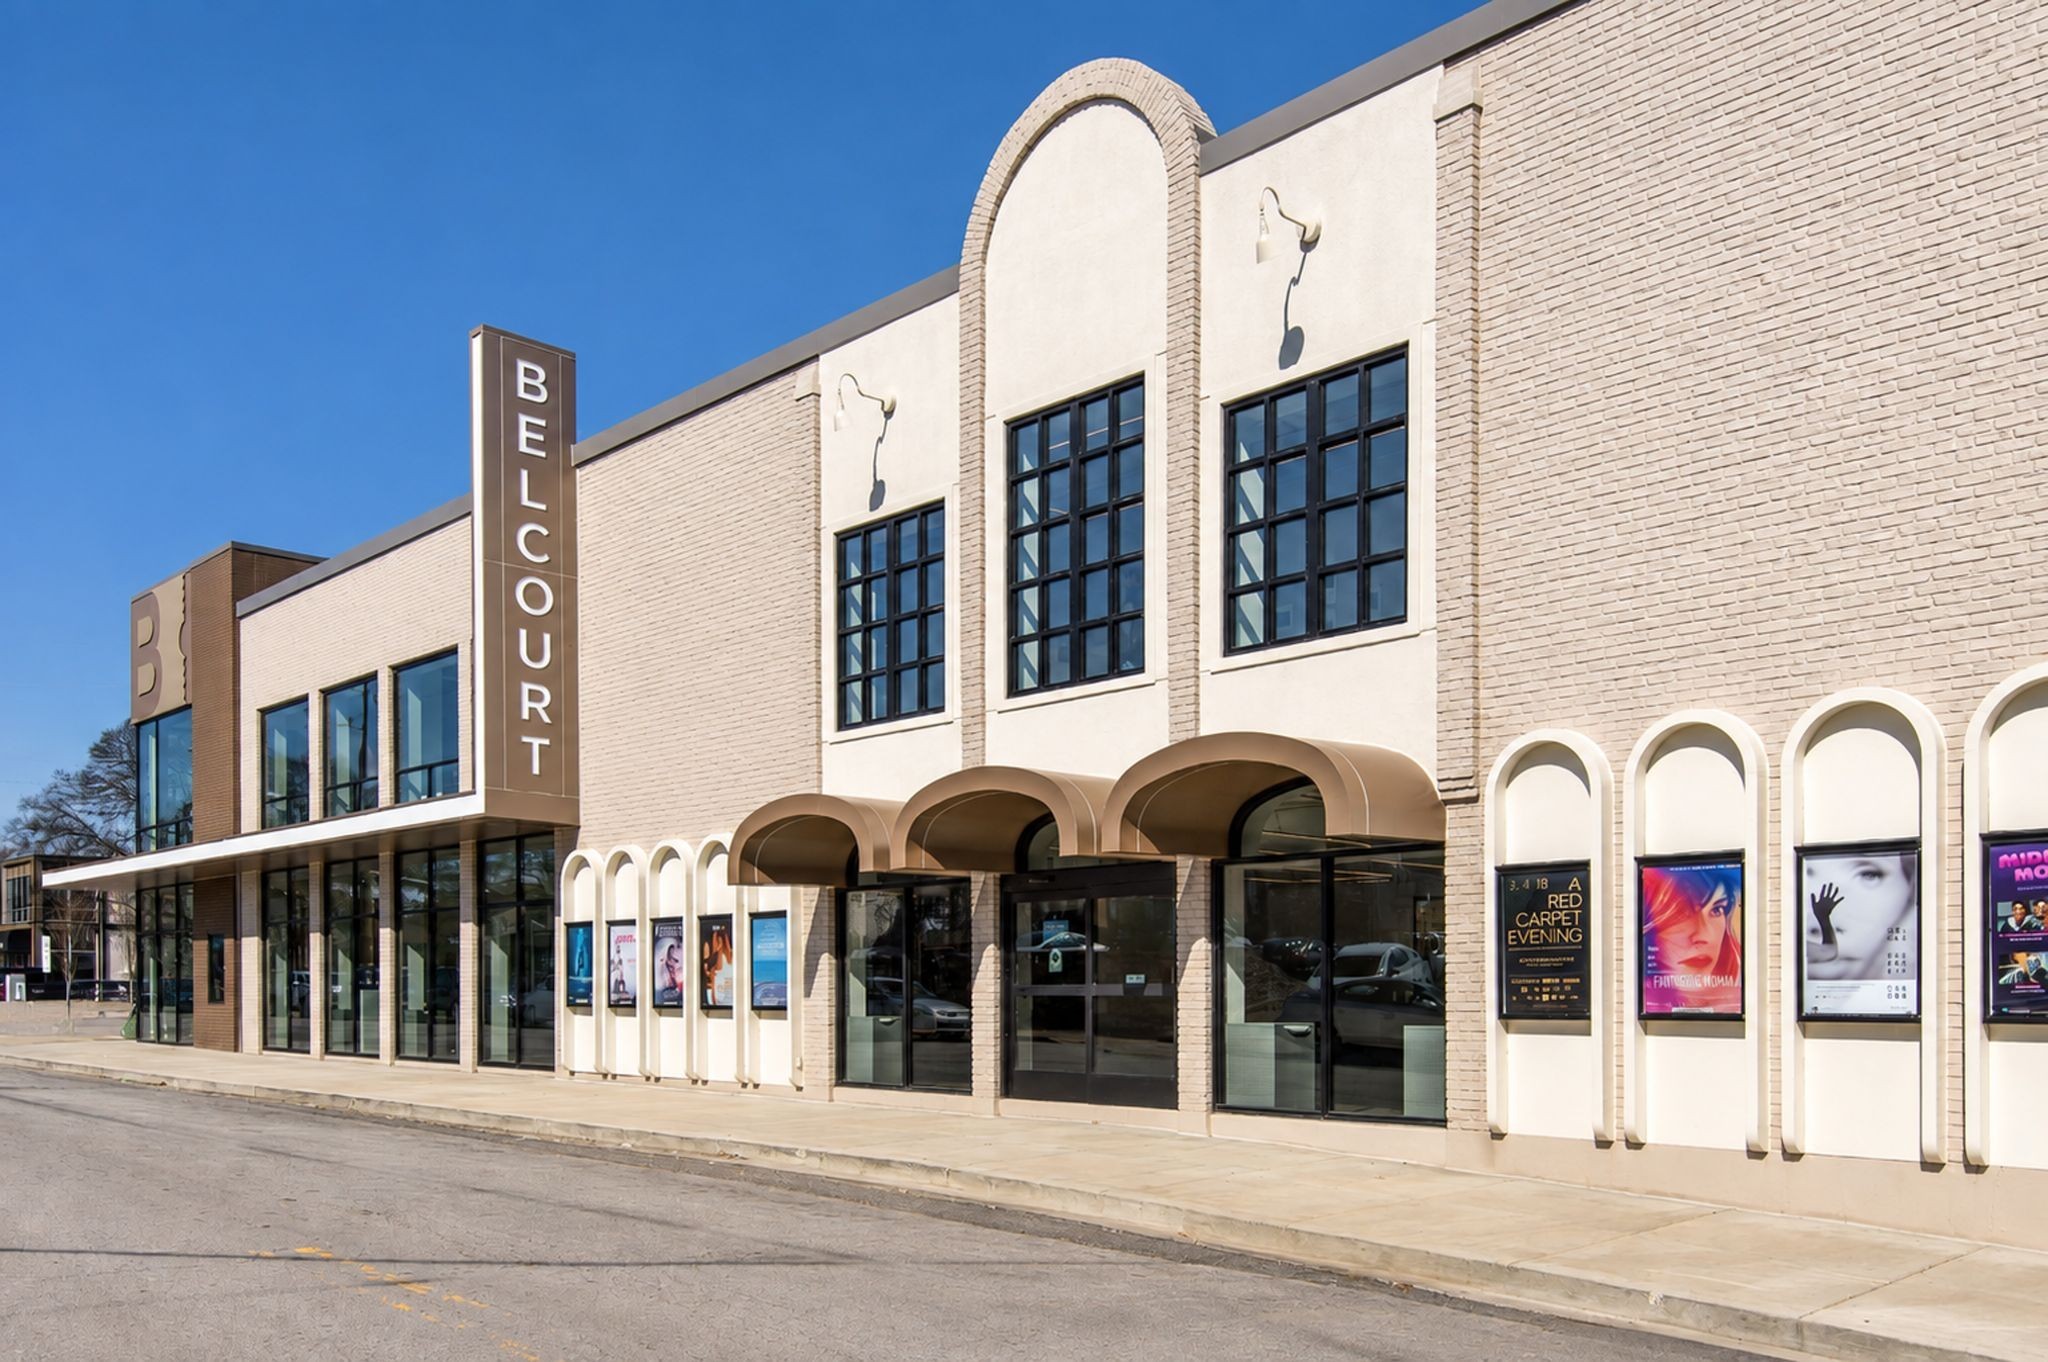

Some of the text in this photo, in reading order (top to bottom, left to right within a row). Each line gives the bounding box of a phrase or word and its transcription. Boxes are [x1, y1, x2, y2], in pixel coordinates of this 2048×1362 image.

[514, 357, 555, 776] BELCOURT
[1568, 877, 1582, 891] A
[1548, 893, 1583, 909] RED
[1515, 910, 1583, 927] CARPET
[1508, 928, 1583, 945] EVENING
